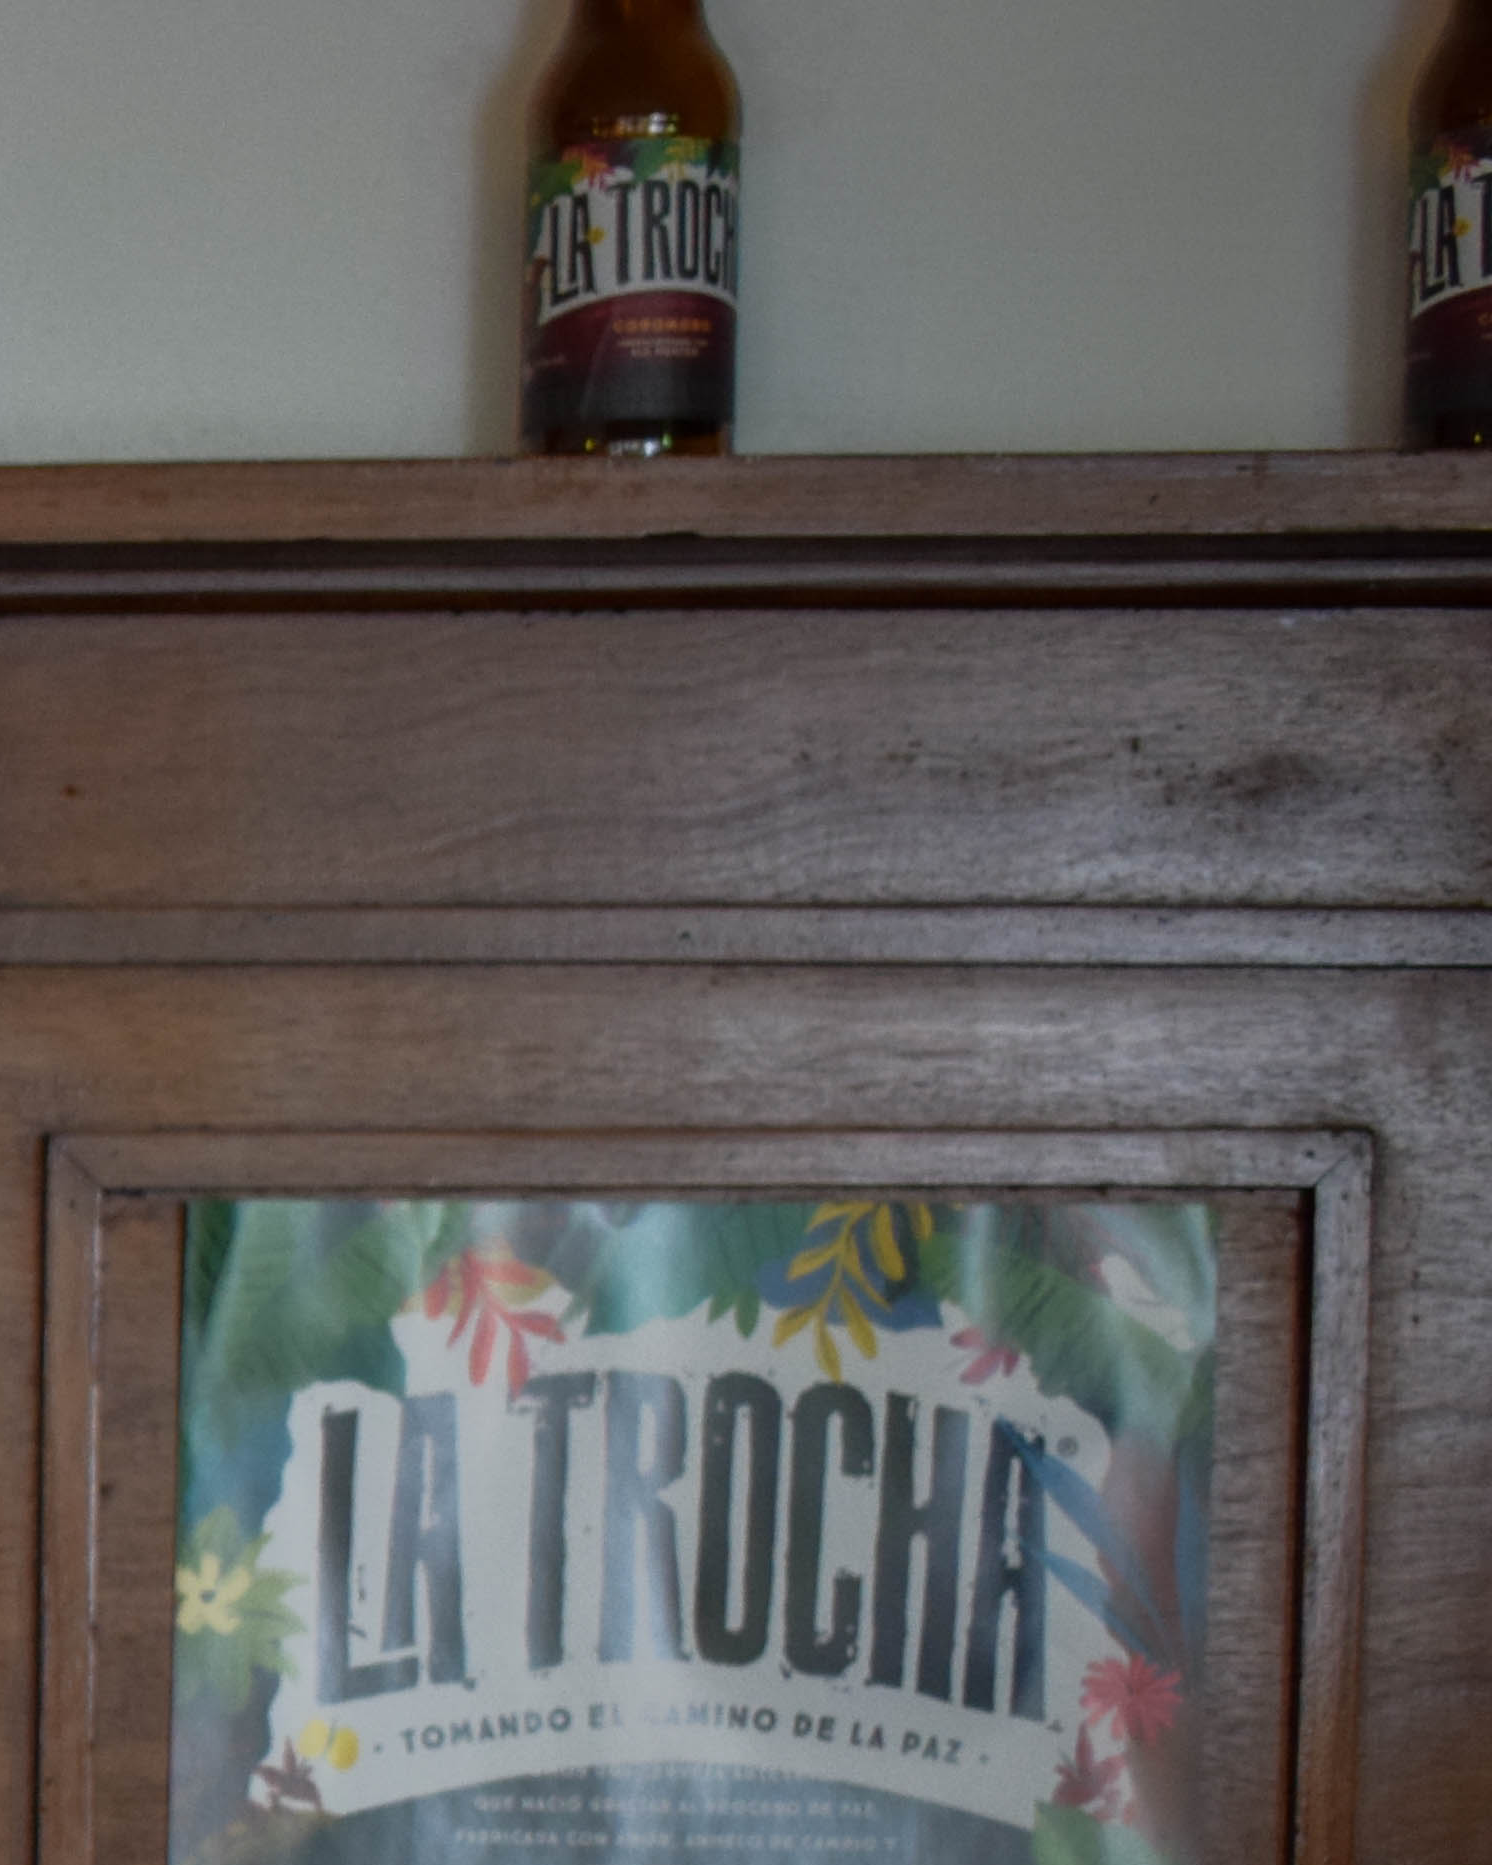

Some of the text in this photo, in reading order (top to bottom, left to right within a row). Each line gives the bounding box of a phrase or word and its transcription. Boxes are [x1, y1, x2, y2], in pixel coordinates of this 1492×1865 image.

[550, 180, 738, 307] LA TROCH
[317, 1368, 1047, 1723] LA TROCHA
[399, 1706, 573, 1754] TOMANDO
[792, 1711, 835, 1743] DE
[848, 1721, 886, 1751] LA
[901, 1731, 963, 1766] PAZ
